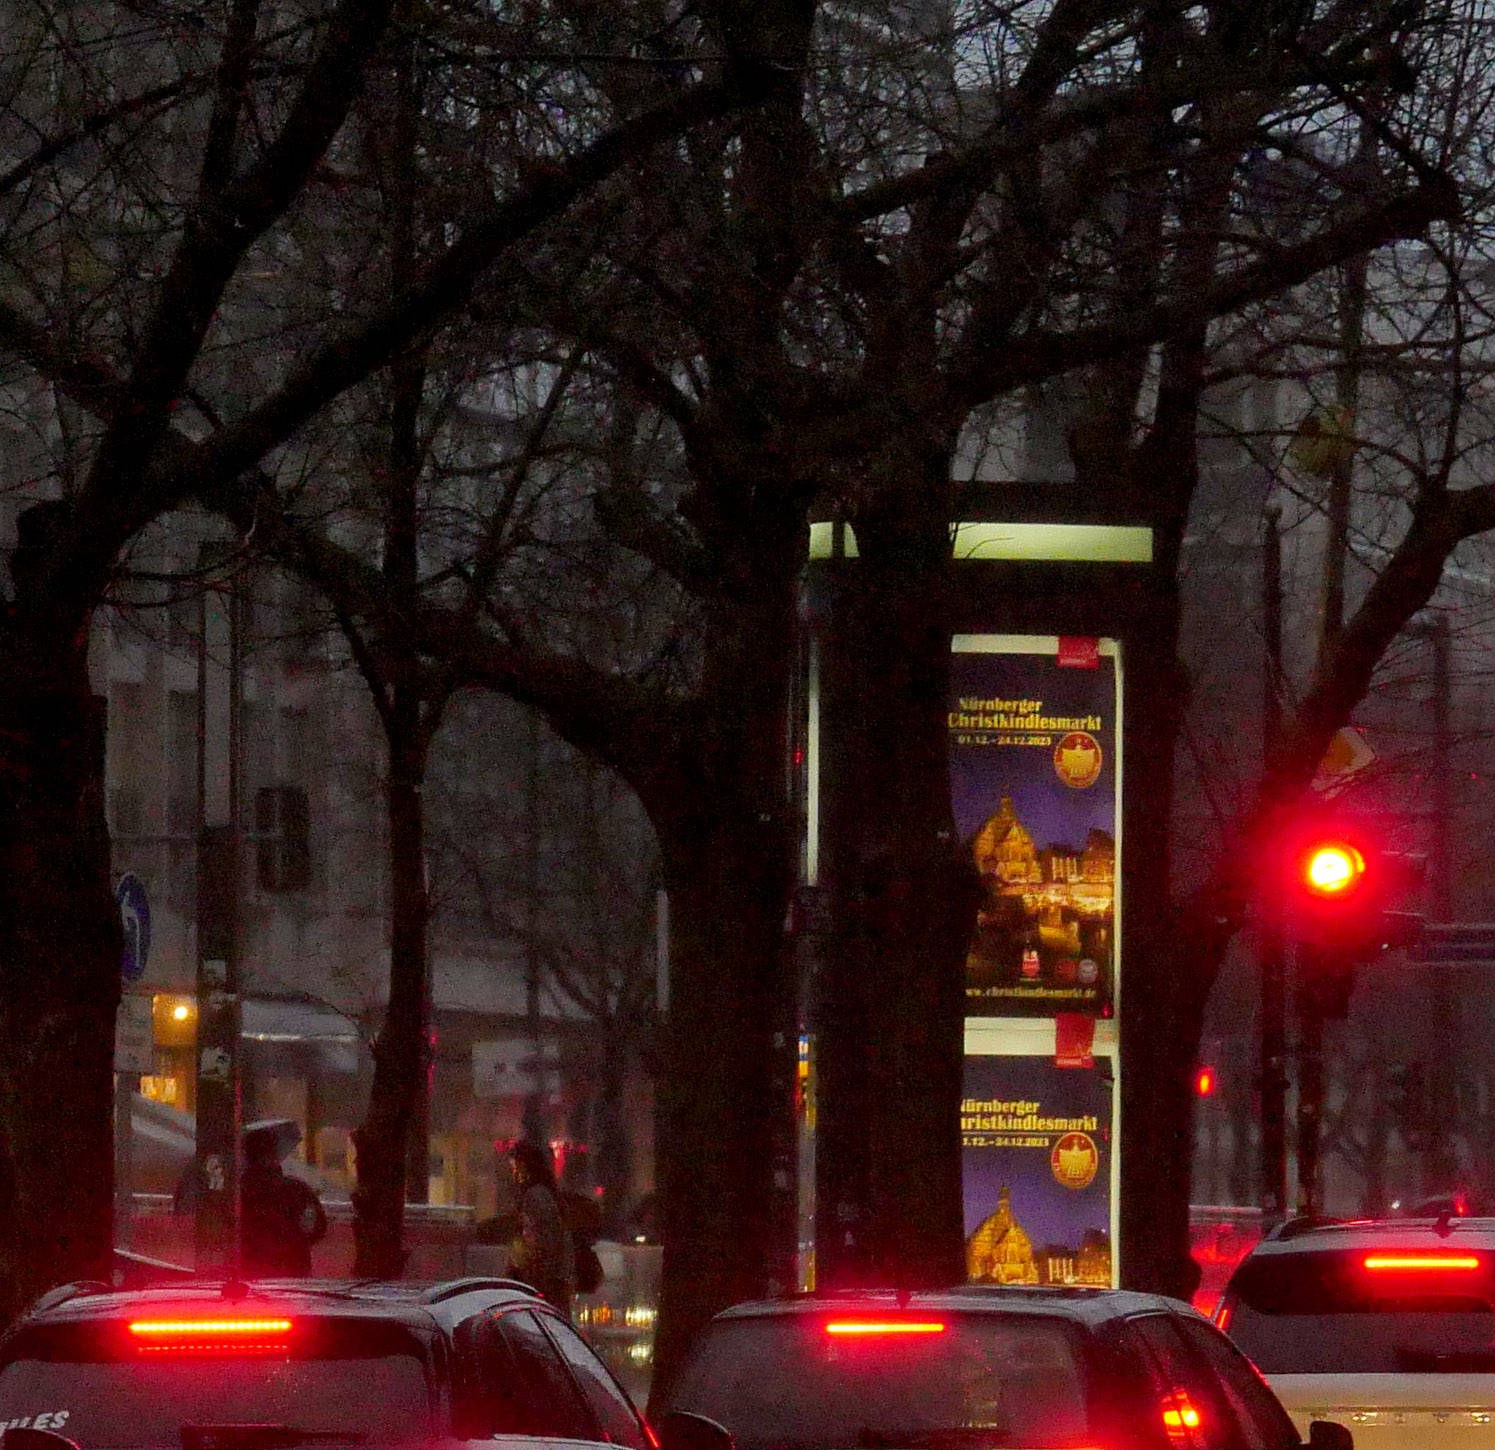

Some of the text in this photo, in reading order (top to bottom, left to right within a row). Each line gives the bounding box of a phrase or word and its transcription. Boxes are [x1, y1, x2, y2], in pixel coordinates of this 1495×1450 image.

[959, 698, 1043, 713] Nürnberger
[948, 713, 1101, 731] Christkindlesmarkt
[961, 1115, 1097, 1131] ristkindlesmarkt
[963, 1136, 987, 1147] 1.12.
